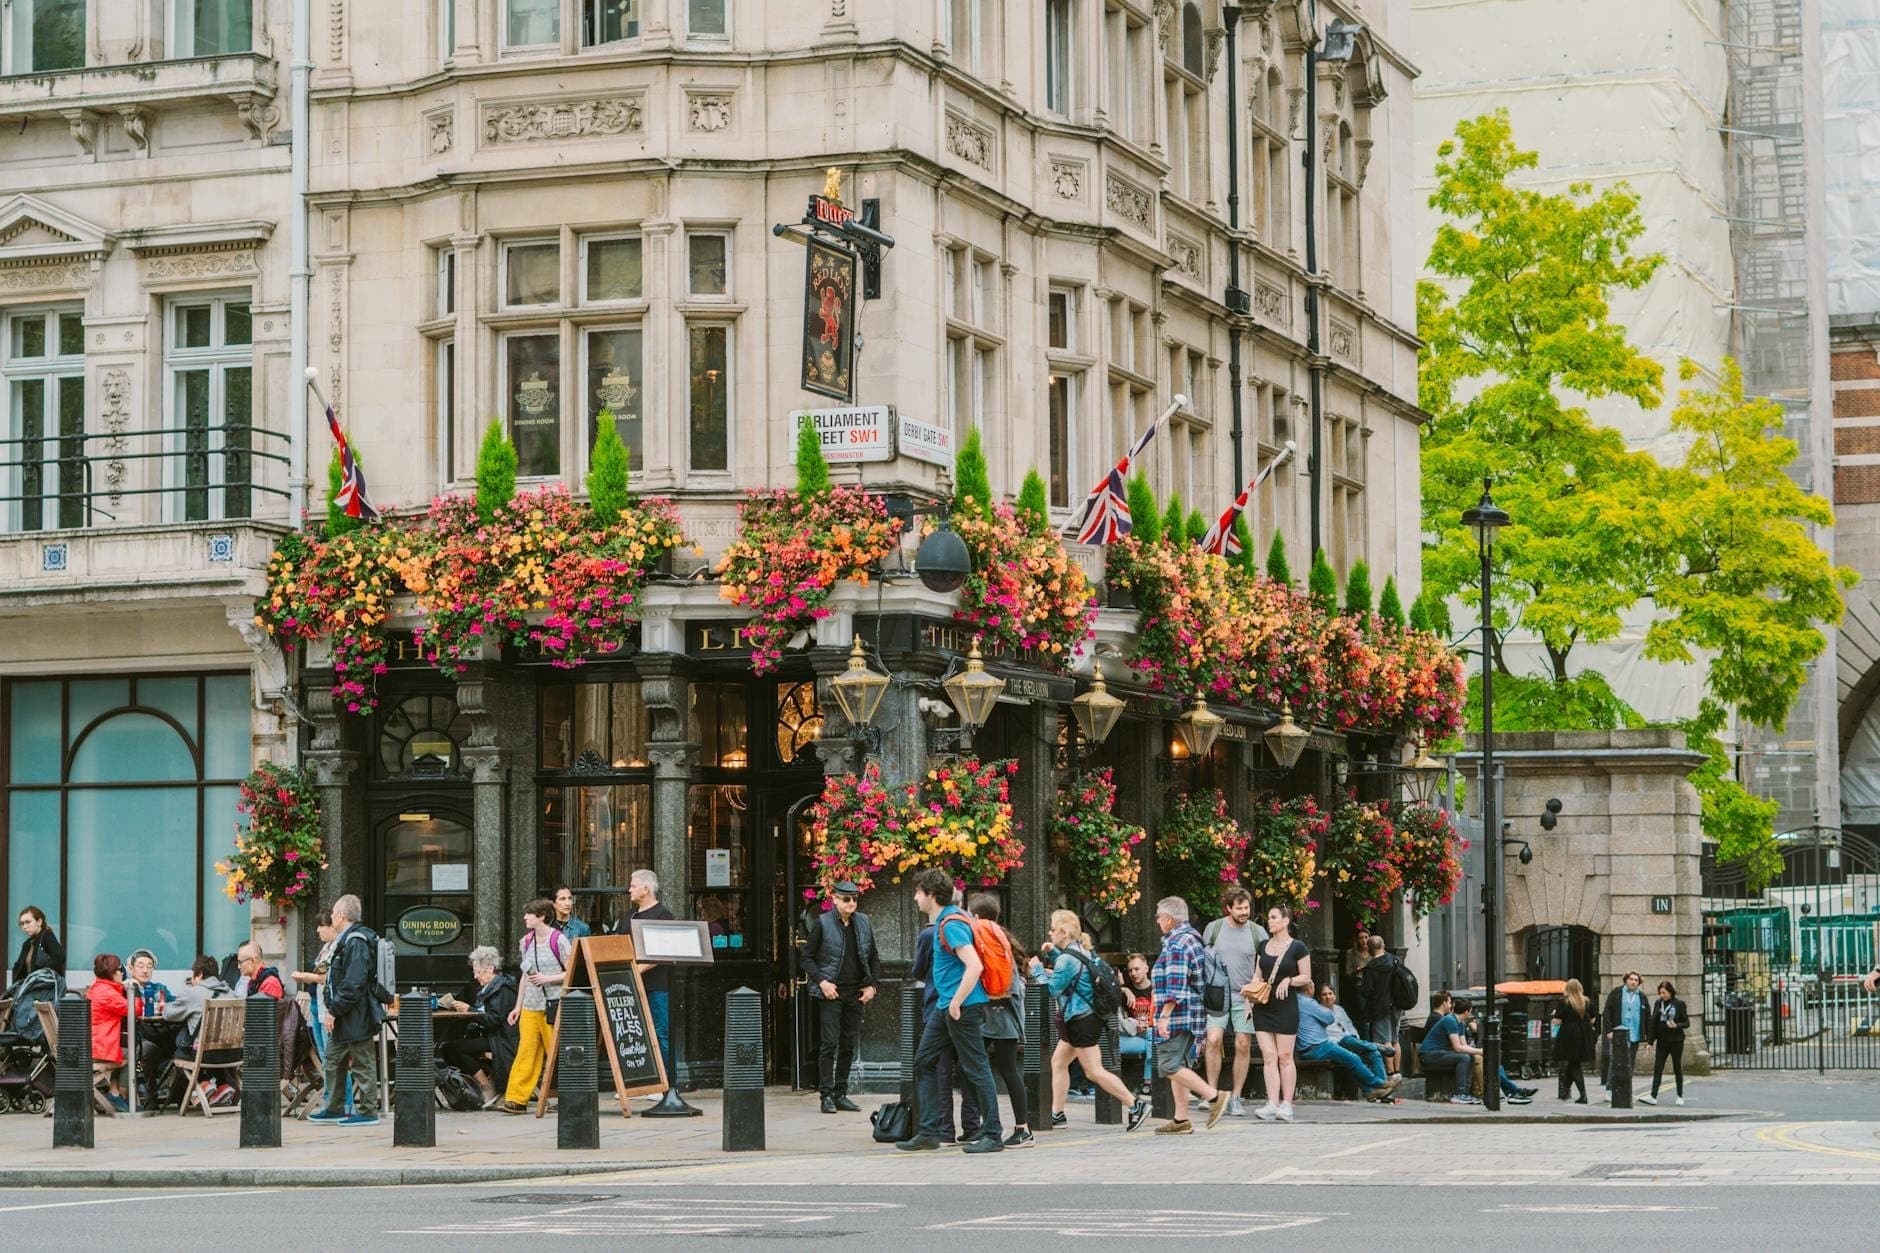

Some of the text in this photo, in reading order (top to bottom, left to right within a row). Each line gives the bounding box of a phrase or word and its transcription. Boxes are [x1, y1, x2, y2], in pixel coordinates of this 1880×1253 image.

[813, 267, 849, 302] RED LION
[850, 429, 878, 443] SW1
[904, 422, 922, 440] DERBY
[923, 428, 936, 445] GATE
[1010, 678, 1023, 695] THE
[1023, 679, 1035, 696] RED
[1656, 898, 1669, 911] IN
[402, 921, 457, 929] DINING ROOM
[610, 1007, 638, 1021] REAL
[616, 1020, 643, 1041] ALES
[627, 1057, 645, 1068] ON TAP
